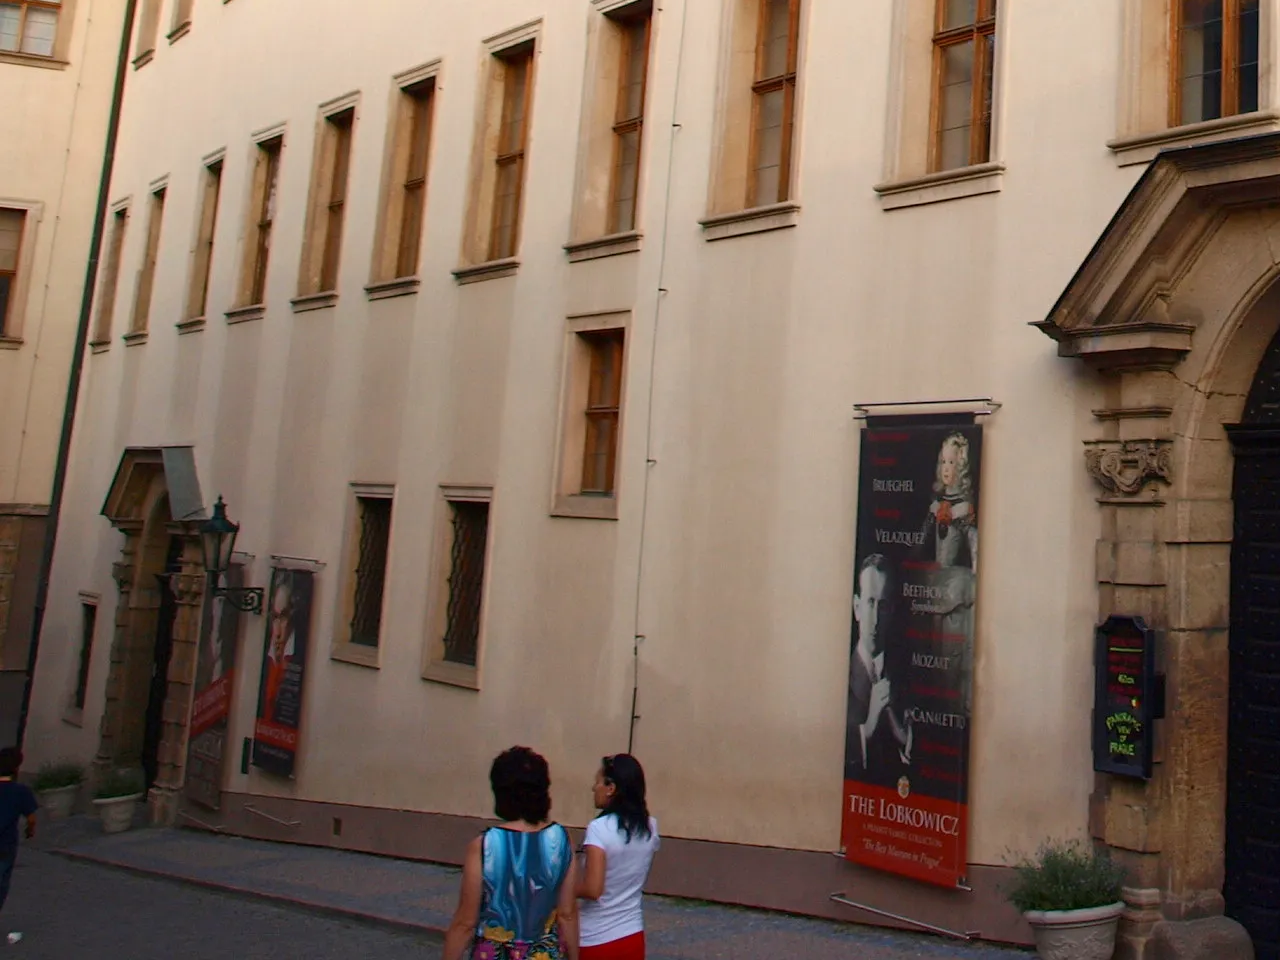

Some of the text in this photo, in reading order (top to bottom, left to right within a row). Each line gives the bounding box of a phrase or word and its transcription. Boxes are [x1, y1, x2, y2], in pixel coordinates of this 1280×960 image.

[912, 654, 950, 670] MOZART
[848, 794, 875, 817] THE
[880, 798, 959, 836] LOBKOWICZ
